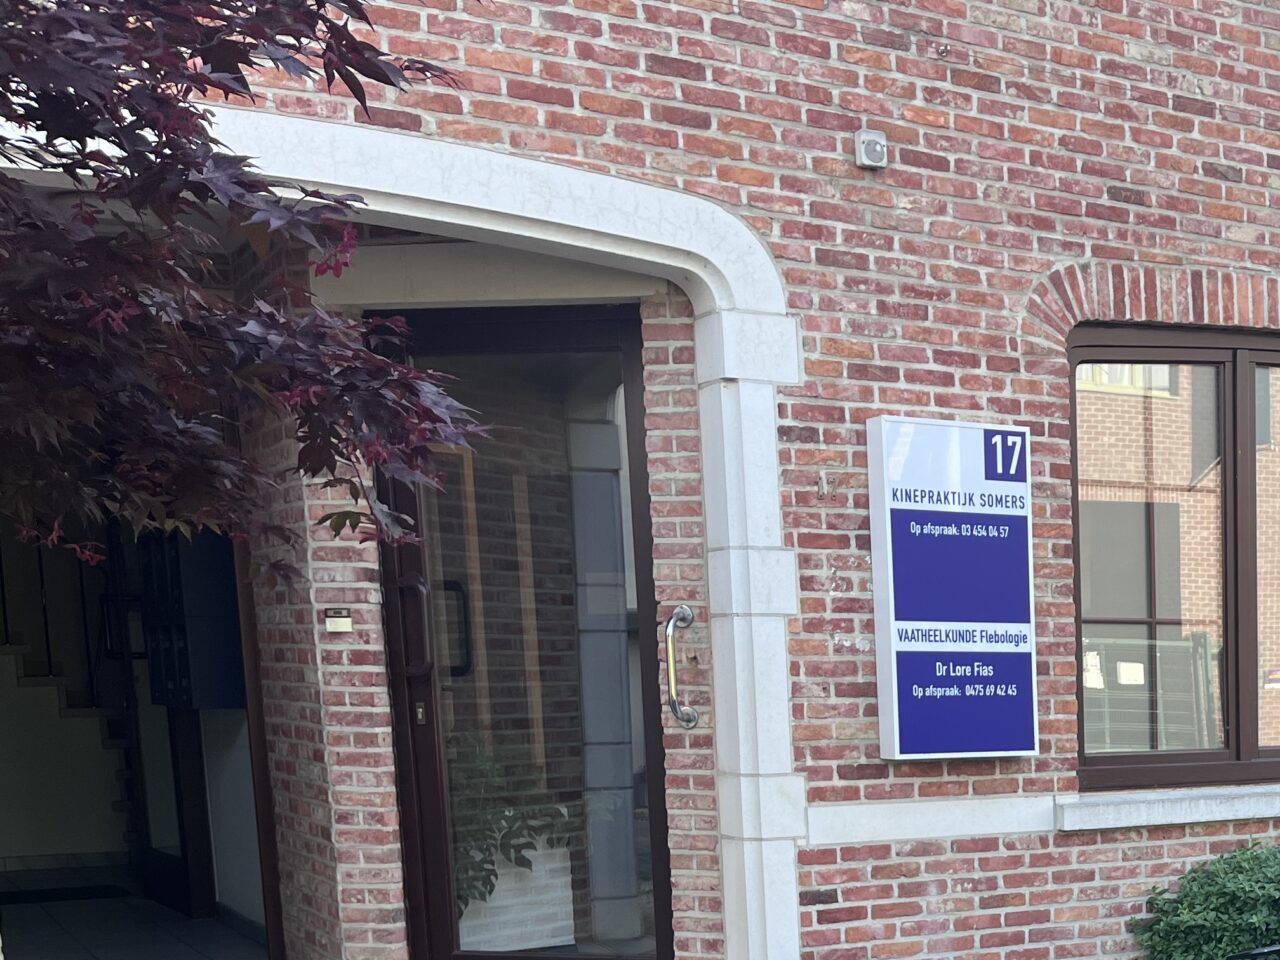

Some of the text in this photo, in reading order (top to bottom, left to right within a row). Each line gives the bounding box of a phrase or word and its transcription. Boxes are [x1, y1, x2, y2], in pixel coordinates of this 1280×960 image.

[991, 434, 1022, 475] 17
[892, 487, 1025, 510] KINEPRAKTIJK SOMERS
[910, 521, 1009, 538] Op afspraak: 03 454 04 57
[897, 628, 1028, 647] VAATHEELKUNDE Flebologie
[935, 662, 994, 677] Dr Lore Fias
[912, 684, 1017, 699] Op afspraak: 0475 69 42 45
